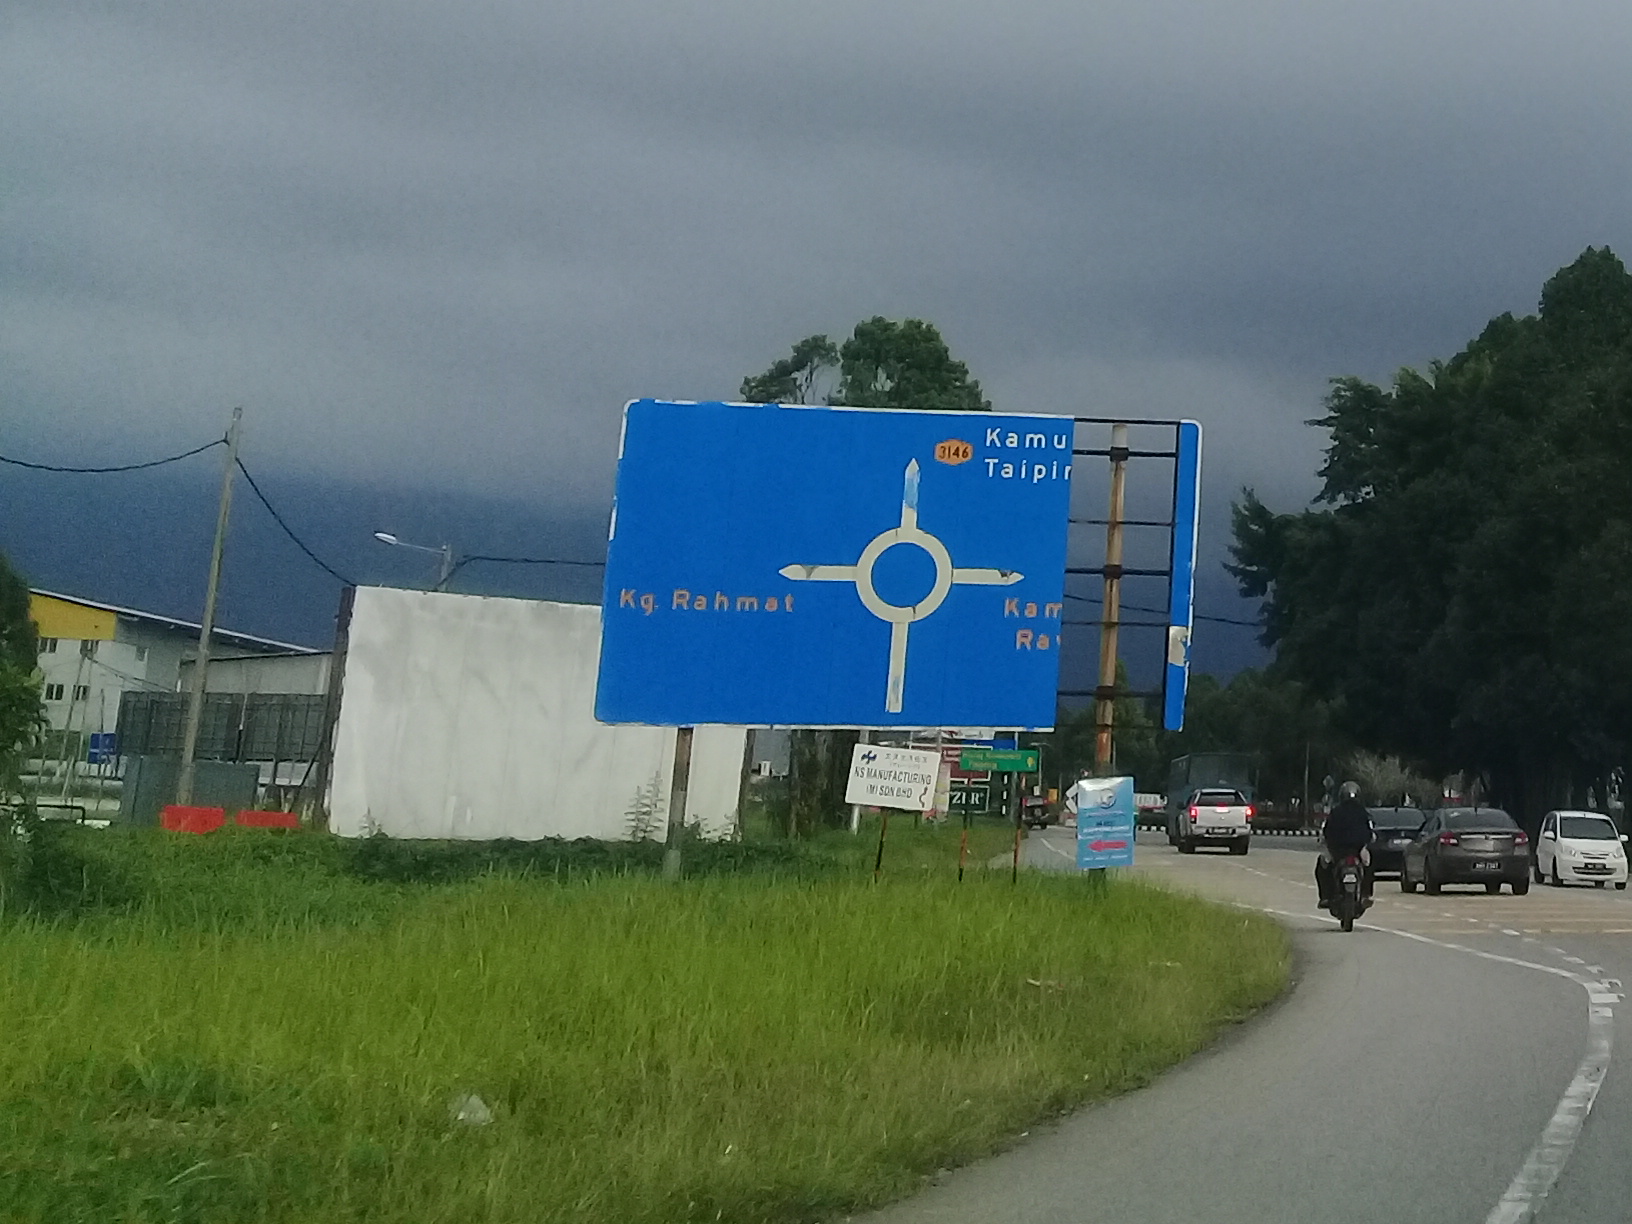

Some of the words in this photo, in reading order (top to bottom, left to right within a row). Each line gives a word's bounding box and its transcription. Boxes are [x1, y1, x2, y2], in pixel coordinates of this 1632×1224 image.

[985, 427, 1067, 449] Kamu
[938, 445, 969, 459] 3146
[671, 588, 794, 613] Rahmat
[854, 766, 866, 779] NS
[866, 767, 932, 786] MANUFACTURING
